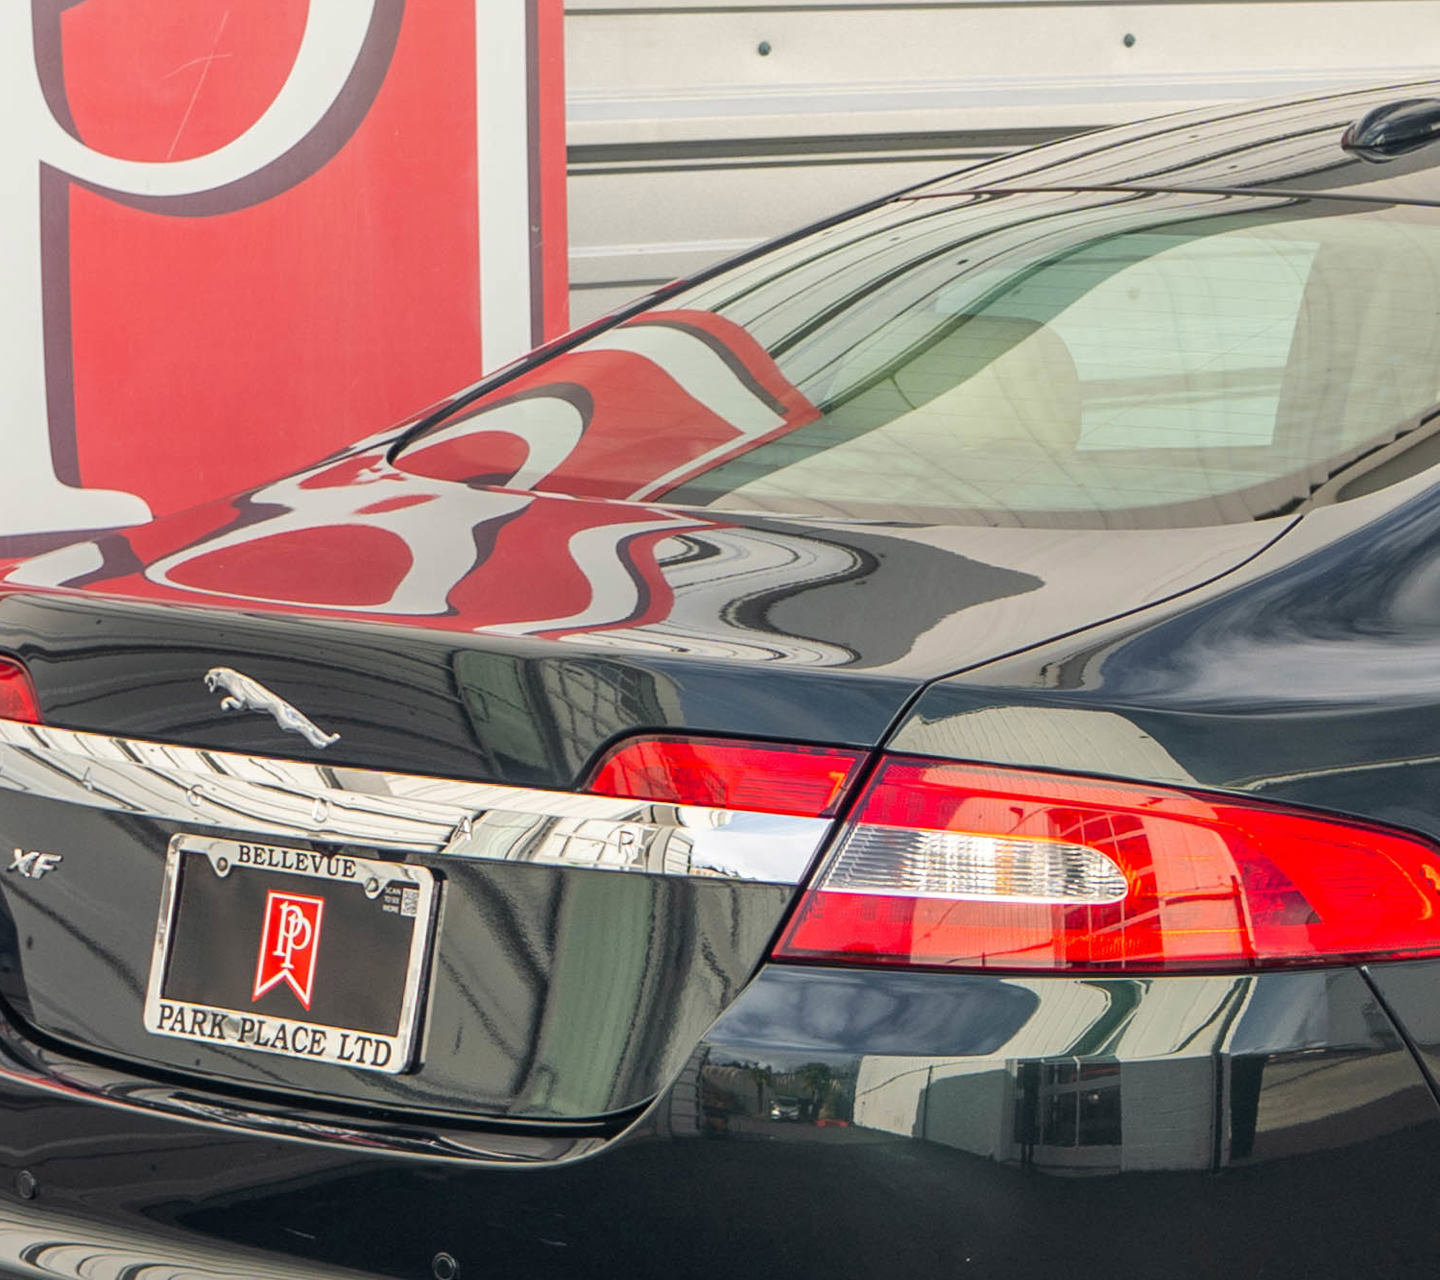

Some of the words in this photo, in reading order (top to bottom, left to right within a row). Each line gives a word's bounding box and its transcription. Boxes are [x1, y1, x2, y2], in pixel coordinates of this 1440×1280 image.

[7, 847, 62, 879] XF
[237, 844, 357, 878] BELLEVUE
[156, 1004, 227, 1040] PARK
[238, 1018, 327, 1056] PLACE
[337, 1033, 392, 1067] LTD
